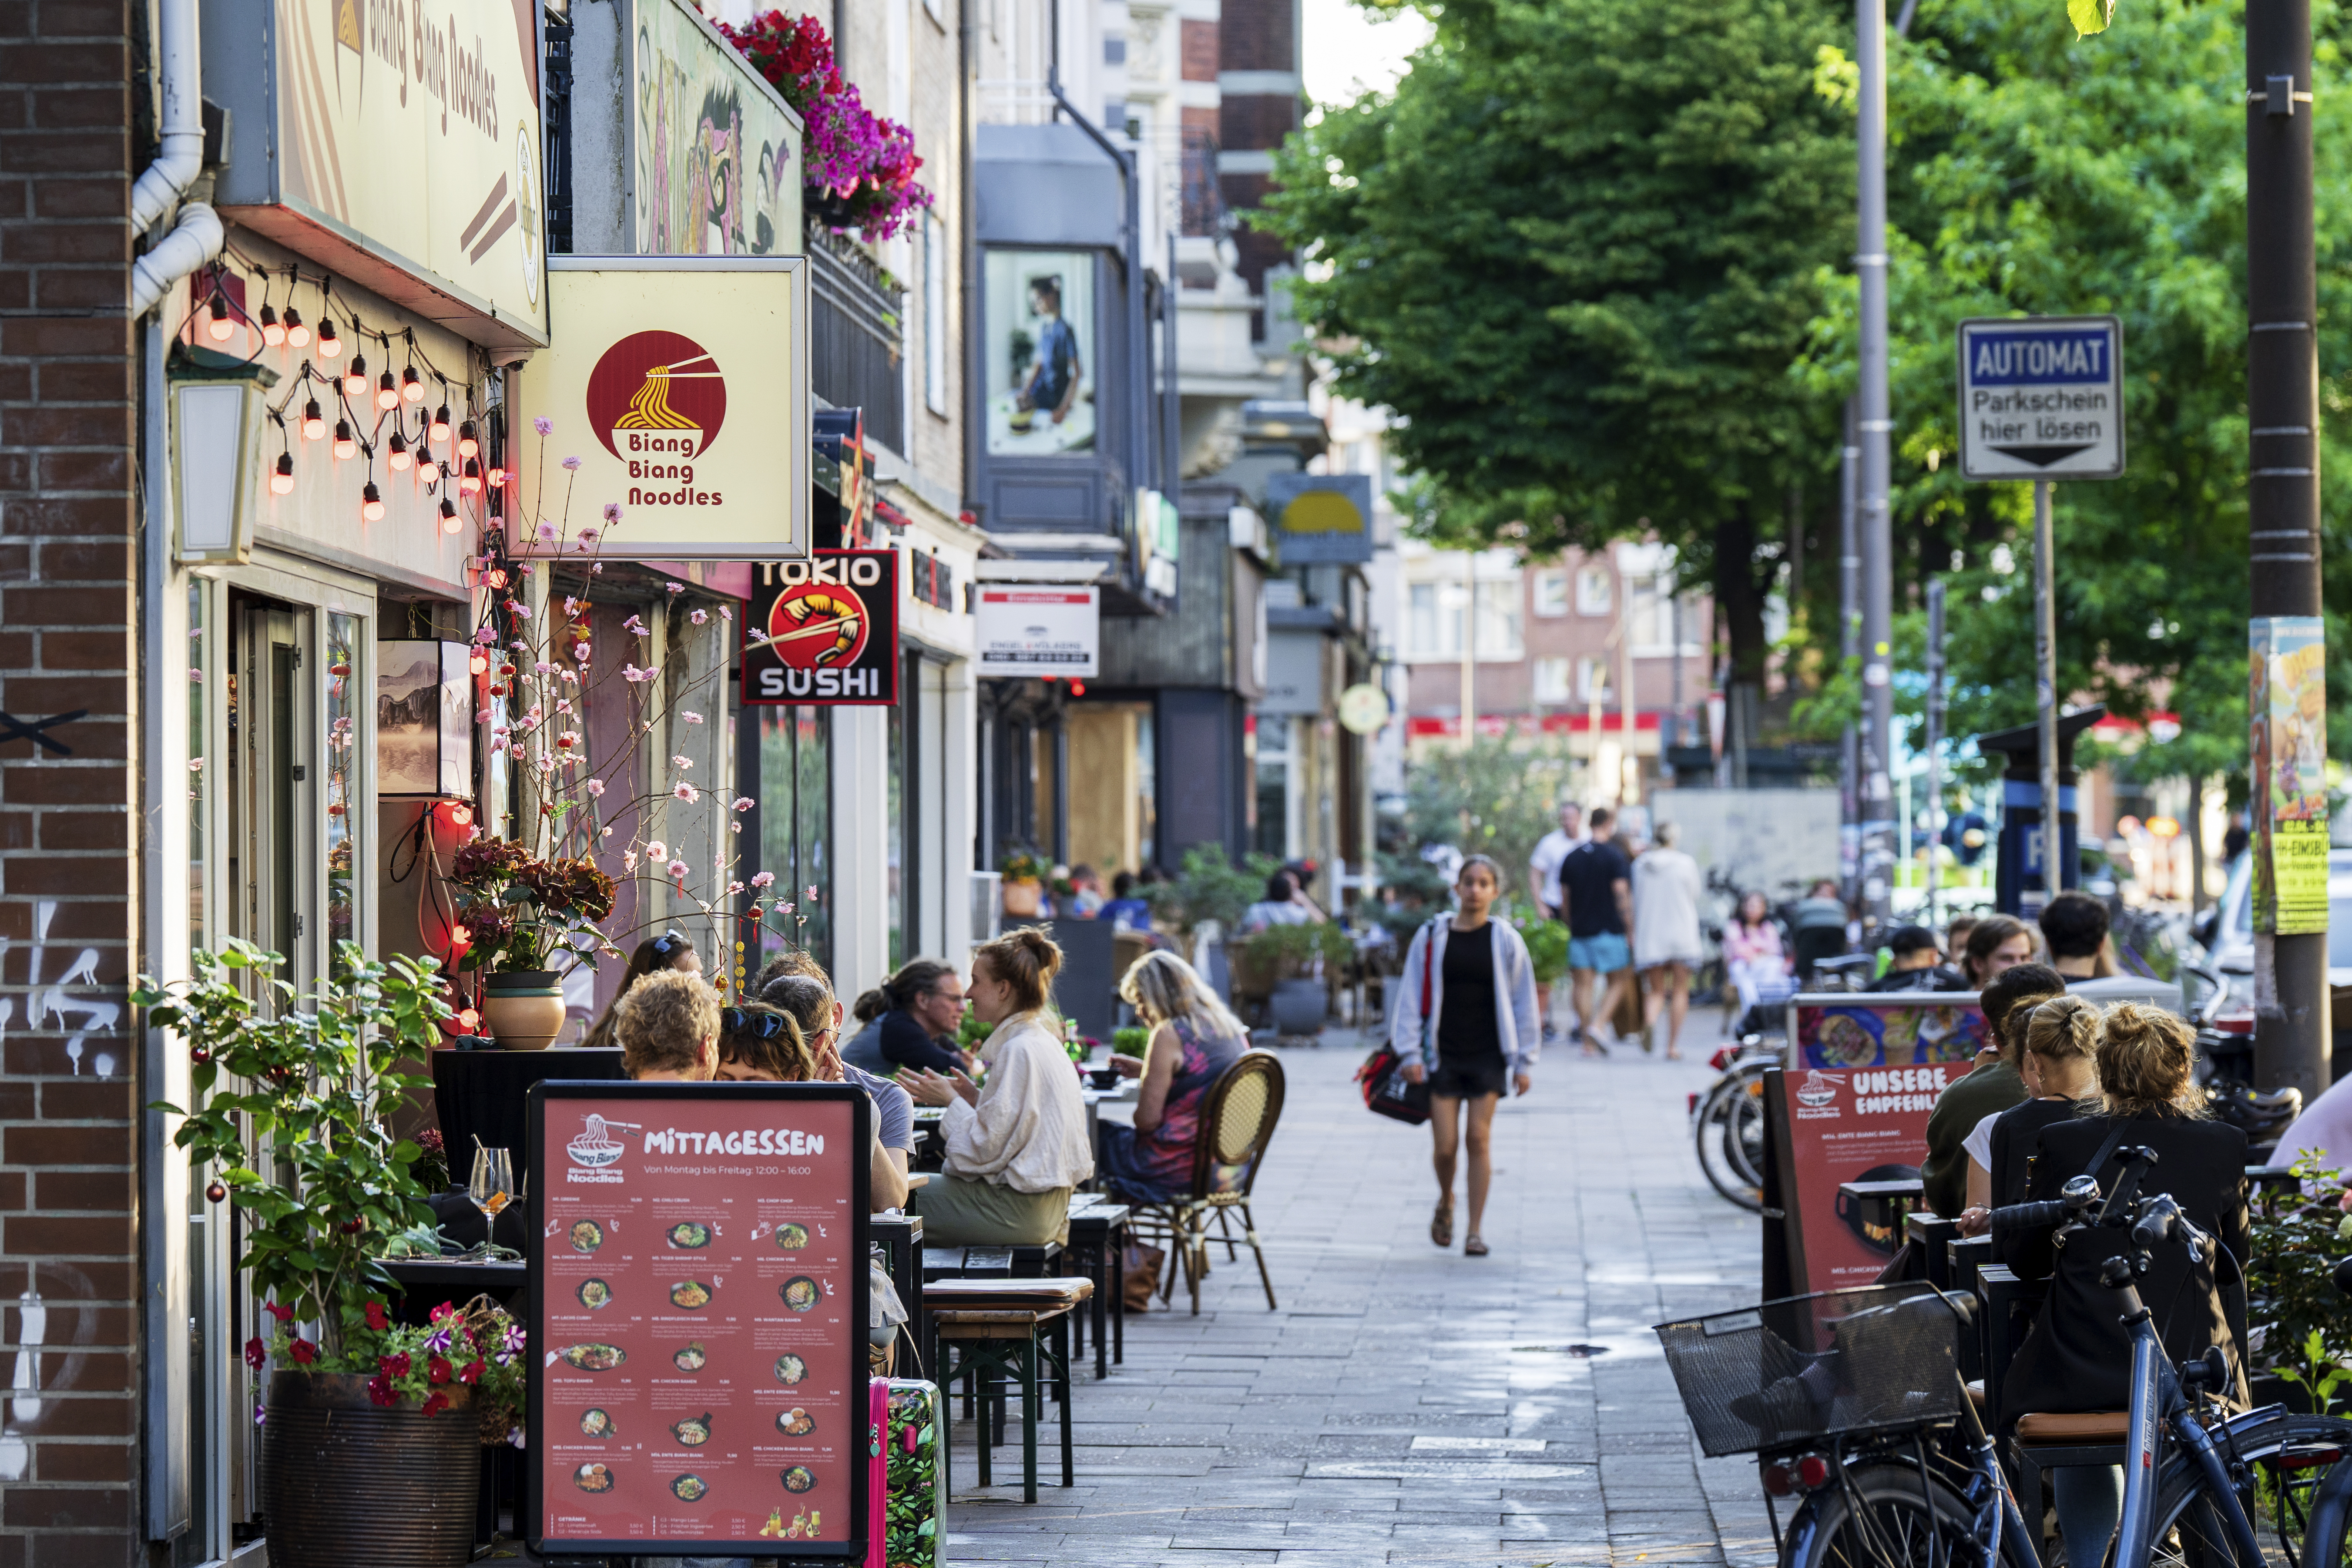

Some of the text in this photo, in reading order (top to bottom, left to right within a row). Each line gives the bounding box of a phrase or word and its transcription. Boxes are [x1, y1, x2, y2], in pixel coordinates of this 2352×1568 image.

[449, 13, 498, 142] Noodles
[1975, 339, 2104, 377] AUTOMAT
[1973, 388, 2107, 413] Parkschein
[1980, 416, 2102, 440] hier lösen
[629, 433, 694, 457] Biang
[629, 460, 694, 484] Biang
[629, 487, 723, 505] Noodles
[759, 557, 880, 586] TOKIO
[760, 668, 879, 696] SUSHI
[1853, 1067, 1947, 1095] UNSERE
[1855, 1093, 1939, 1115] EMPFEHL
[567, 1174, 624, 1183] Noodles
[644, 1165, 660, 1174] Von
[664, 1165, 701, 1176] Montag
[703, 1165, 716, 1174] bis
[718, 1165, 754, 1176] Freitag:
[755, 1166, 779, 1175] 12:00
[787, 1167, 811, 1175] 16:00
